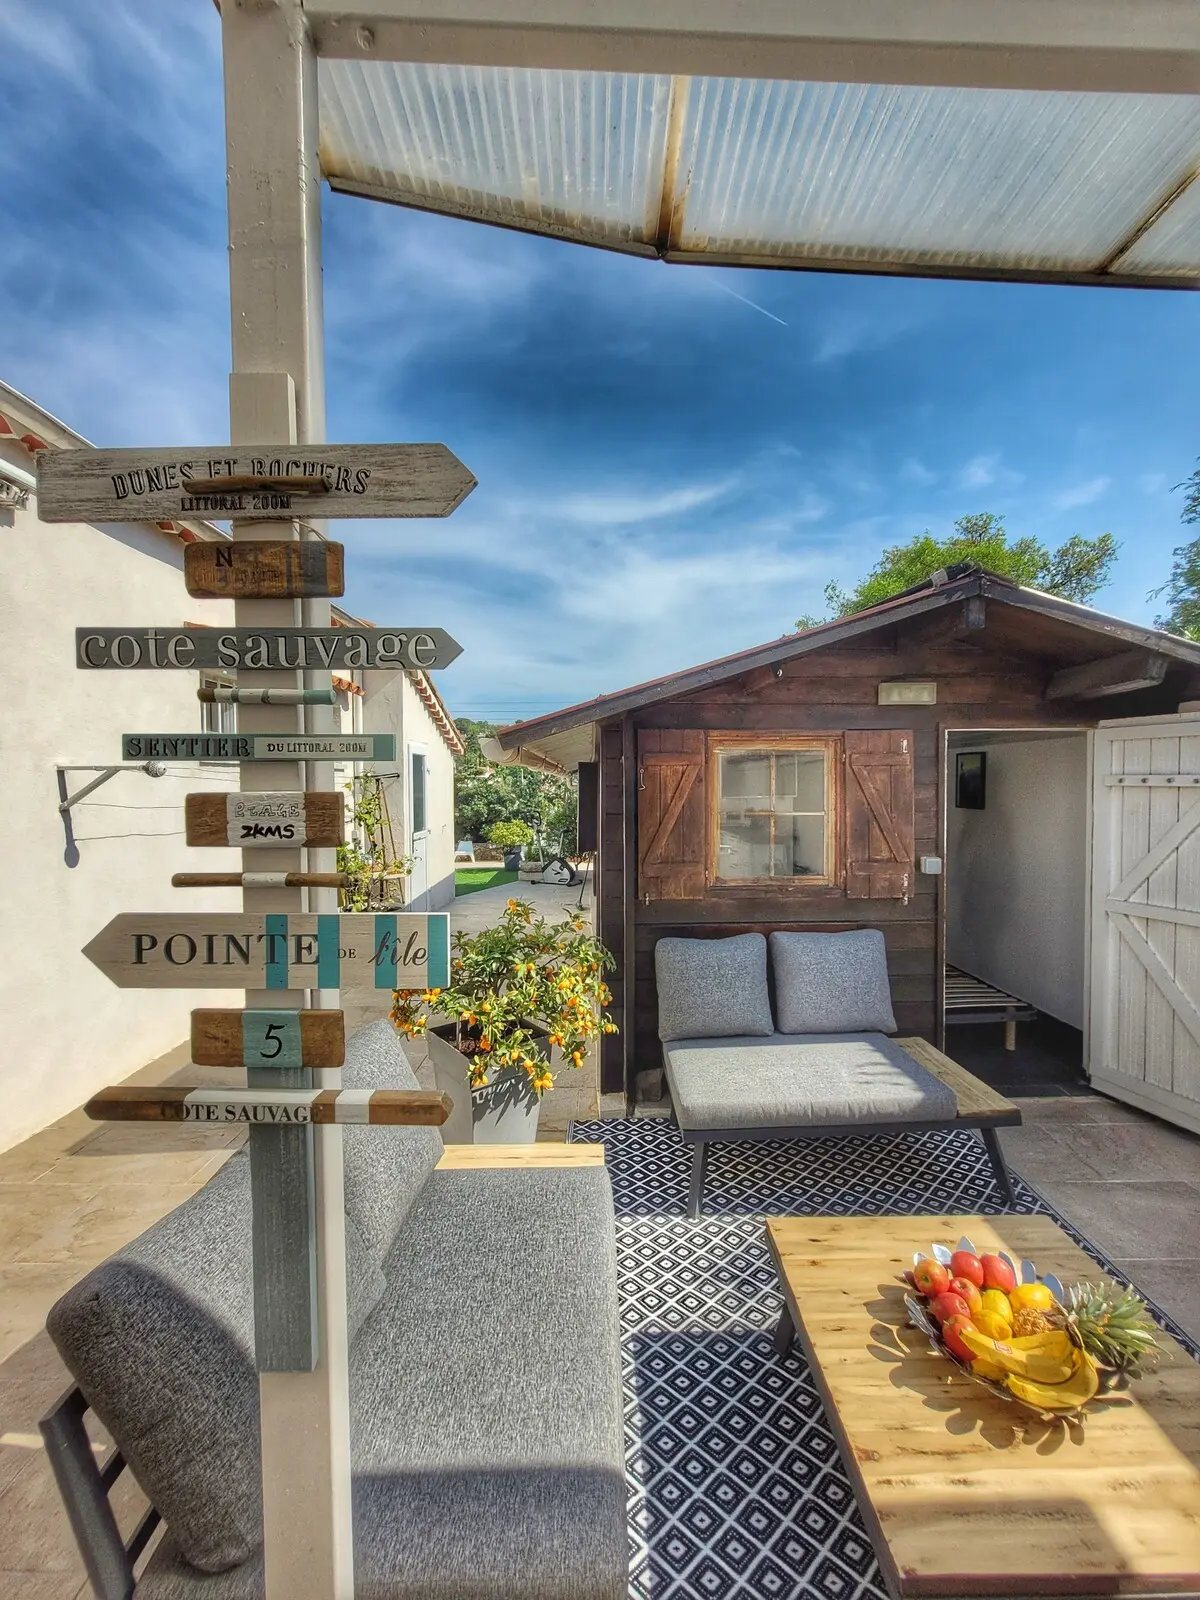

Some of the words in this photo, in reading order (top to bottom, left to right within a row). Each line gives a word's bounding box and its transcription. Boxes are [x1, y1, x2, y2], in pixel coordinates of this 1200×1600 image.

[111, 461, 195, 499] DUNES
[251, 458, 371, 494] ROCHERS
[80, 628, 196, 668] cote
[217, 632, 437, 669] sauvage
[126, 737, 251, 757] SENTIER
[266, 743, 285, 752] DU
[286, 742, 335, 753] LITTORAL
[234, 802, 300, 818] PLAGE
[130, 933, 320, 965] POINTE
[337, 948, 357, 959] DE
[260, 1023, 286, 1059] 5
